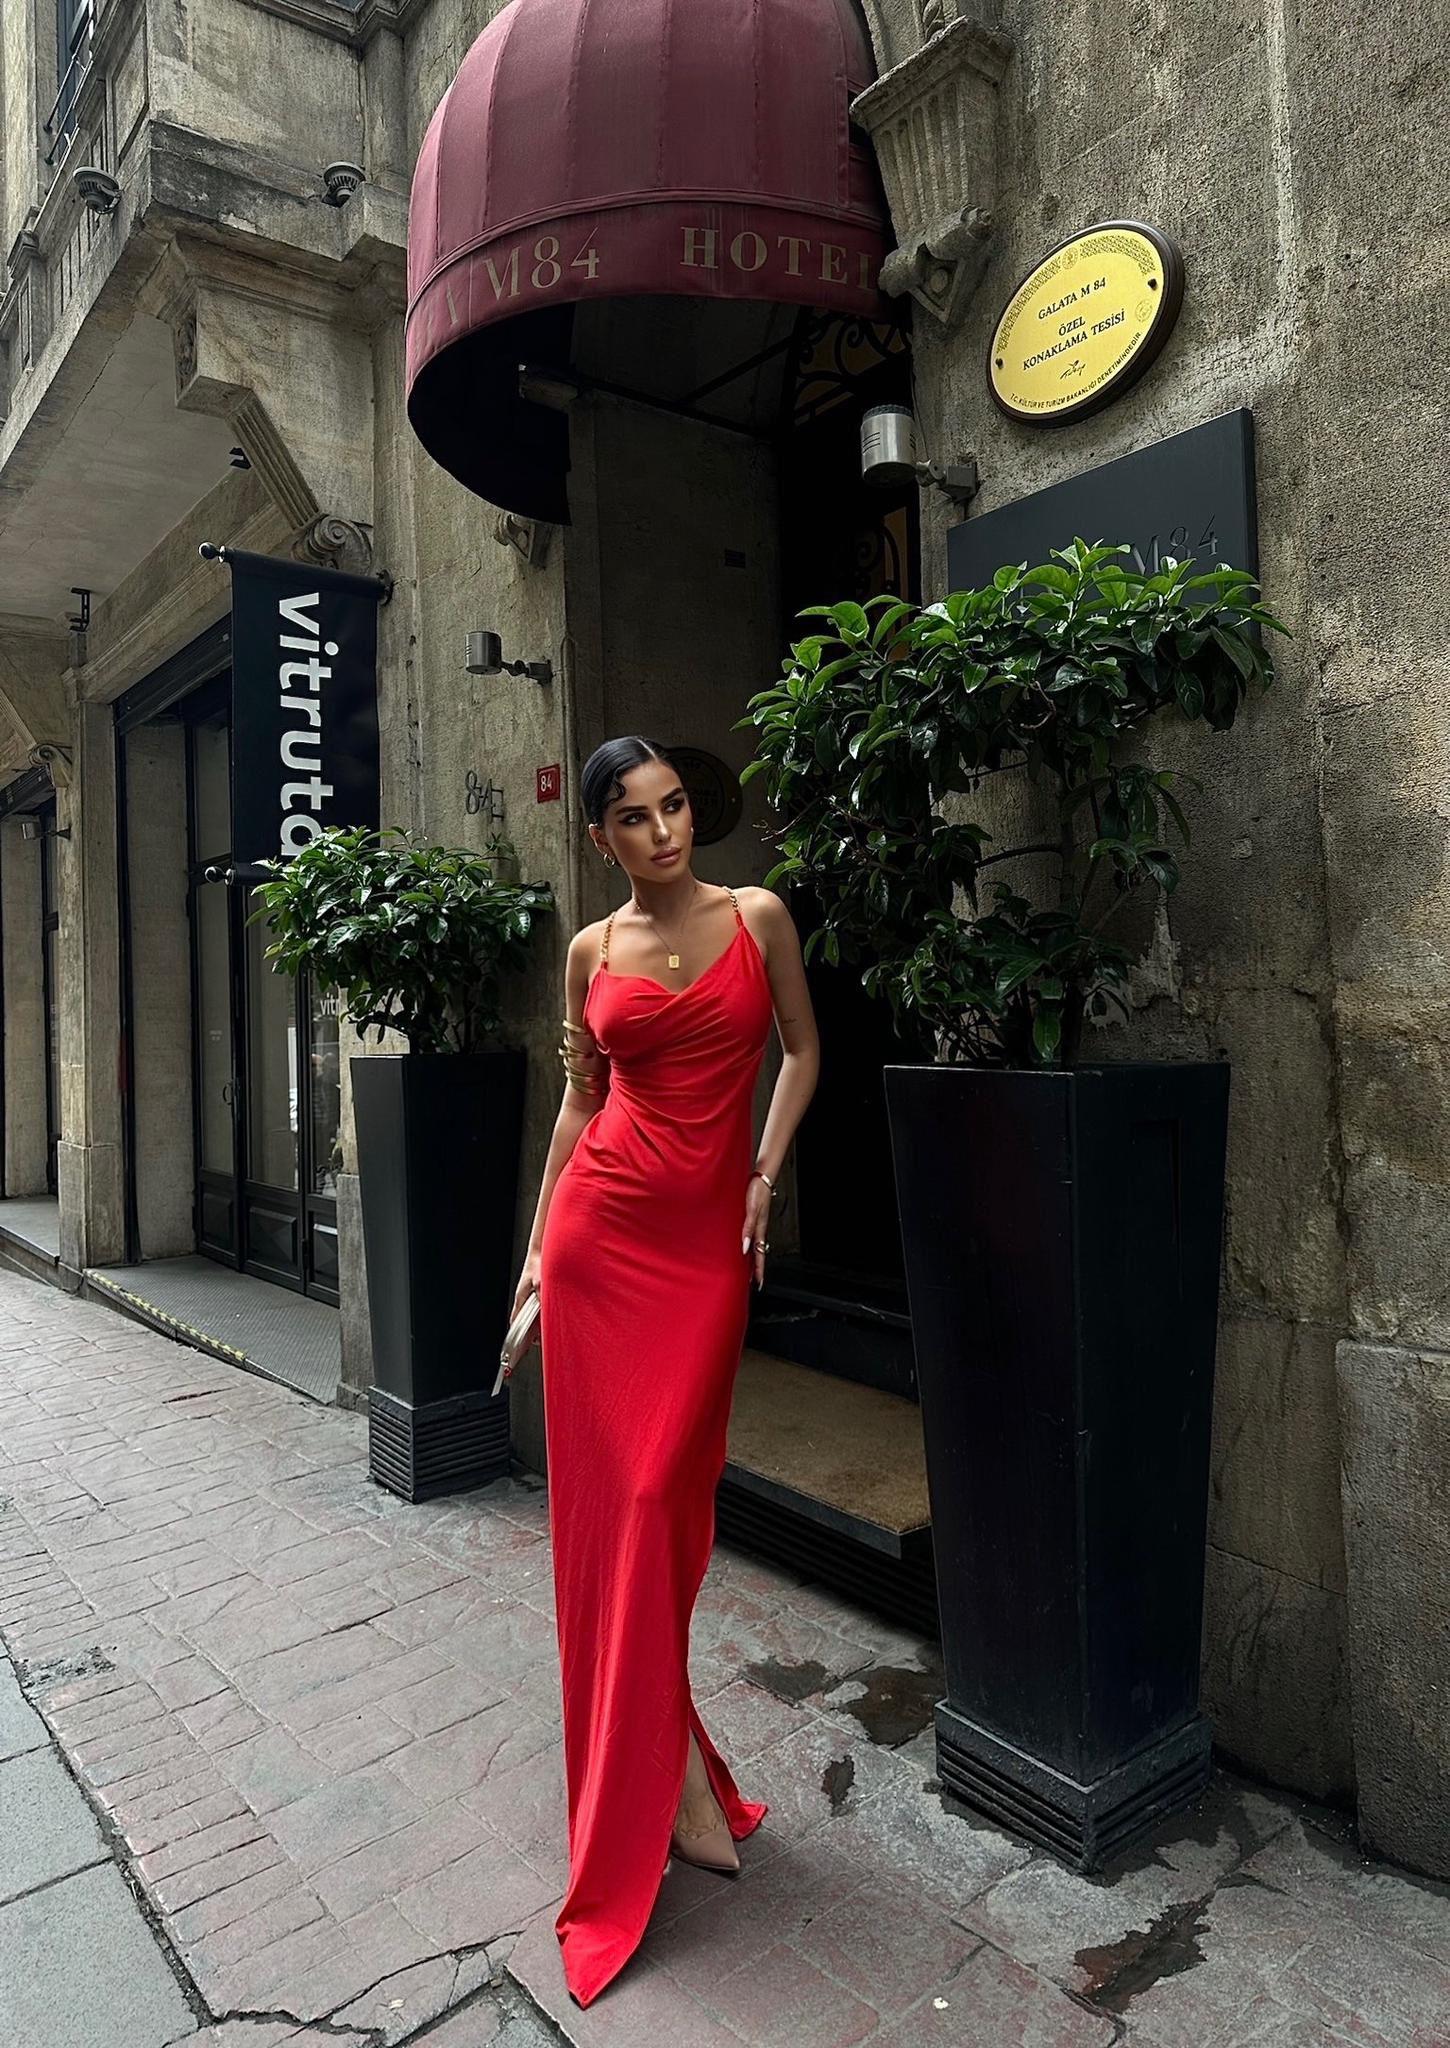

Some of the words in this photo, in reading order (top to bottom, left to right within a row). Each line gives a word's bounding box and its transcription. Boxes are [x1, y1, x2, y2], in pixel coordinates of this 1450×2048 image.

[483, 224, 600, 301] M84
[1038, 292, 1078, 320] GALATA
[1080, 284, 1091, 298] M
[1093, 277, 1106, 291] 84
[1058, 316, 1086, 336] ÖZEL
[1022, 331, 1089, 371] KONAKLAMA
[1090, 308, 1126, 336] TESİSİ
[1131, 513, 1219, 576] M84
[279, 592, 339, 857] vitruta
[540, 774, 552, 792] 84
